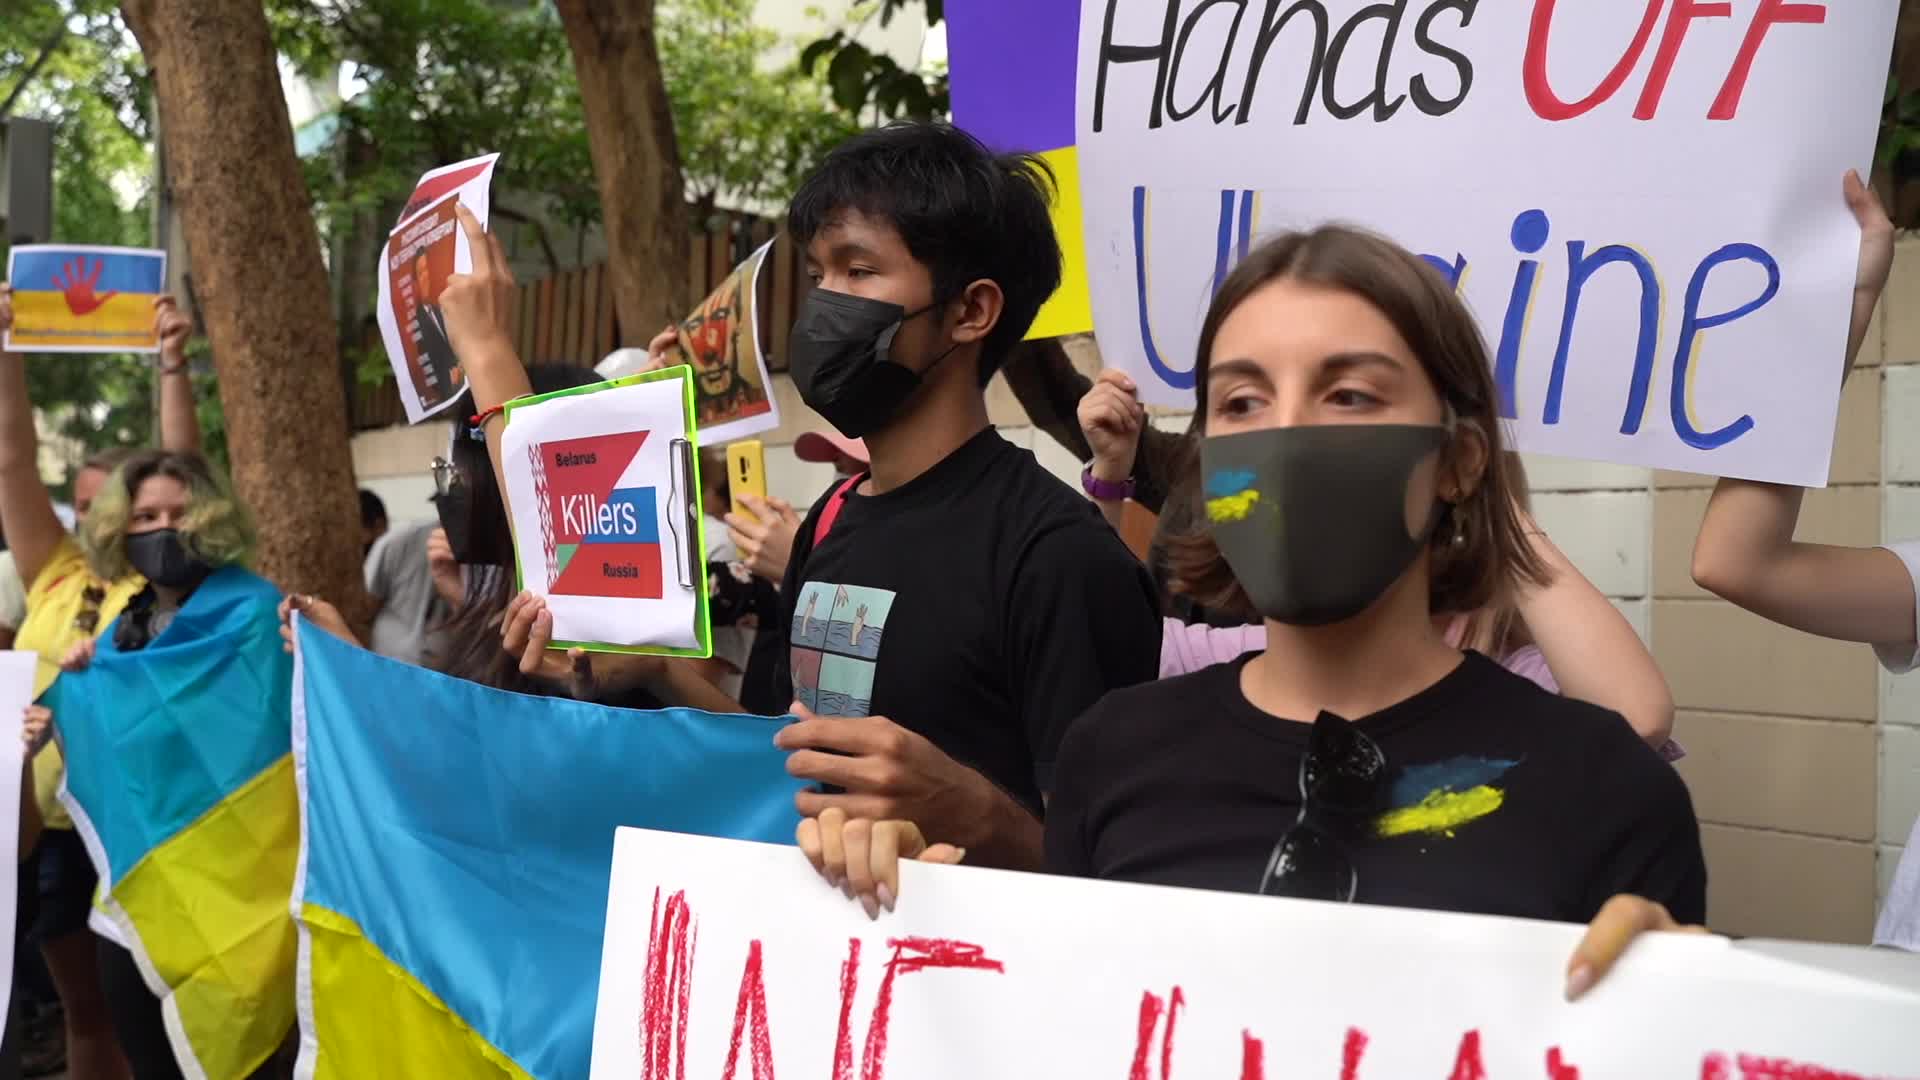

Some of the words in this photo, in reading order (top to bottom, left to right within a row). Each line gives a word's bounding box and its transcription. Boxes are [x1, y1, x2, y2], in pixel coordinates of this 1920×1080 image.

[555, 451, 597, 467] Belarus
[560, 493, 638, 536] Killers
[602, 562, 639, 579] Russia
